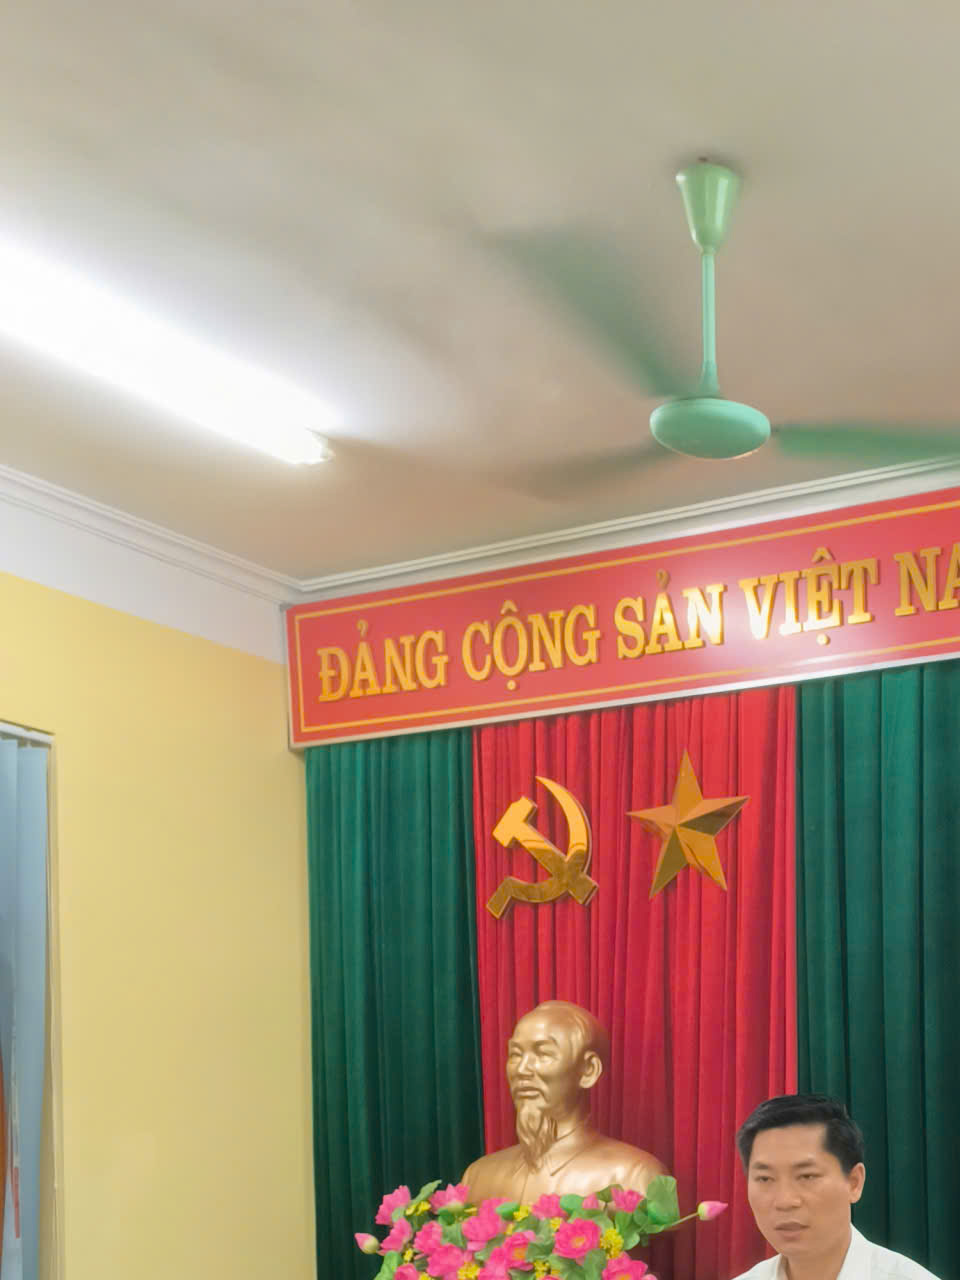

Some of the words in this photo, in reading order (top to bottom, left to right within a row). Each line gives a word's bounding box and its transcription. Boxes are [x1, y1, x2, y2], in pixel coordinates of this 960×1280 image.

[316, 619, 448, 703] ĐẢNG
[462, 600, 600, 691] CỘNG
[615, 569, 725, 661] SẢN
[738, 546, 880, 647] VIỆT
